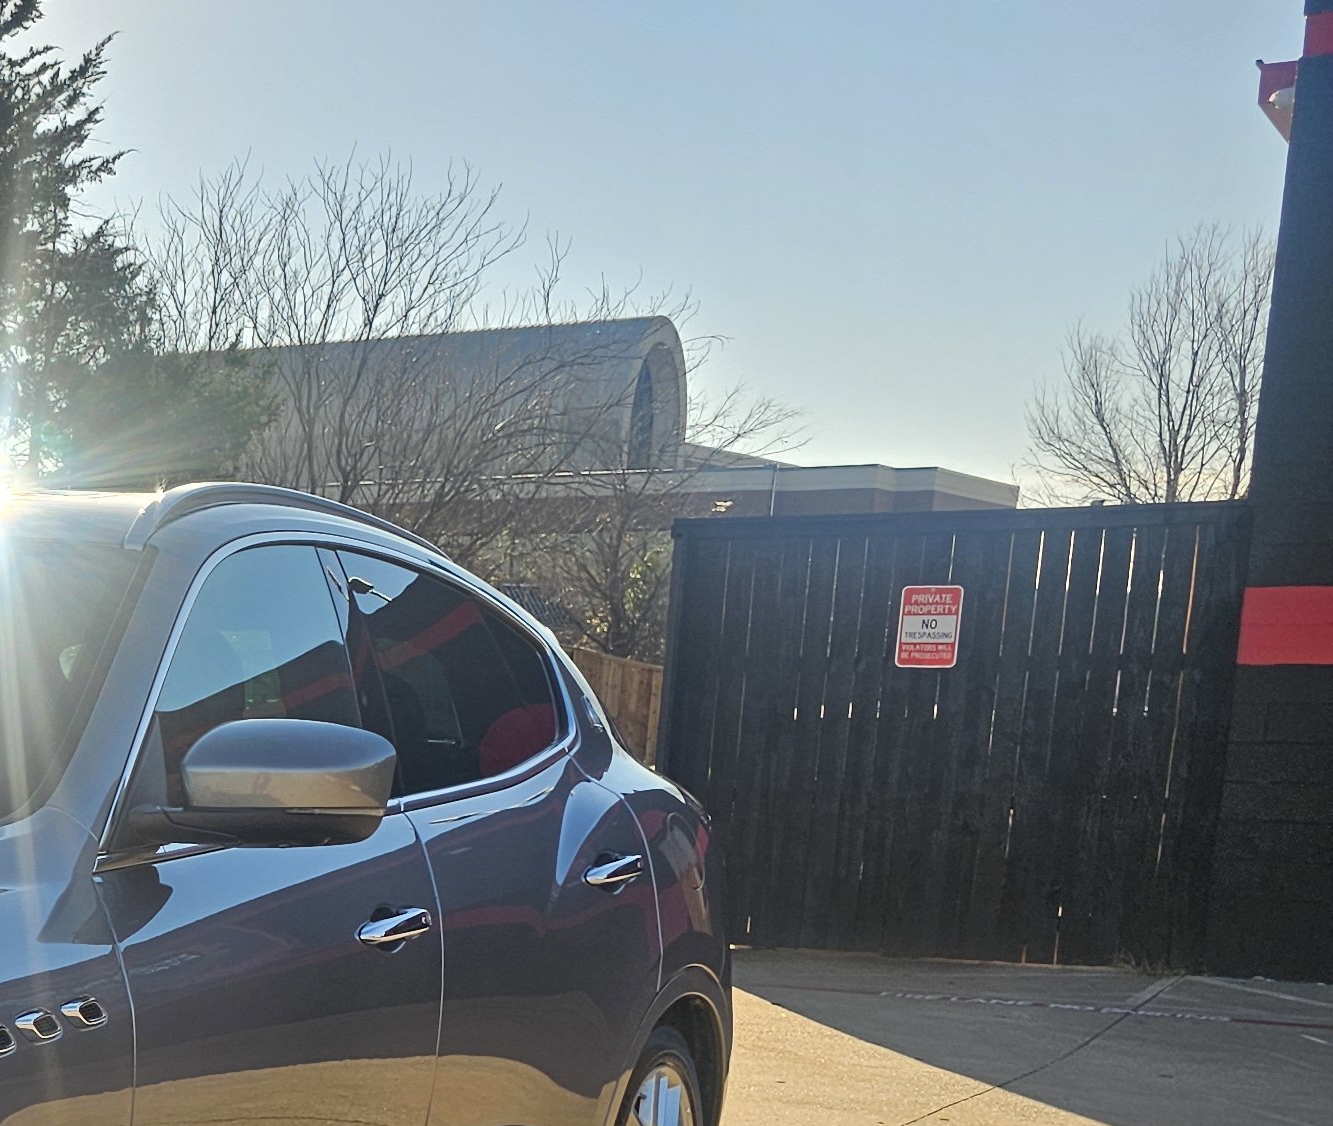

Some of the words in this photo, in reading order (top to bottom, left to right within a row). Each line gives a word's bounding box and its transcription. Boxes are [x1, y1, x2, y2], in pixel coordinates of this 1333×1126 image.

[911, 593, 953, 603] PRIVATE
[904, 604, 958, 614] PROPERTY
[921, 618, 938, 630] NO
[904, 631, 953, 640] TRESPASSING
